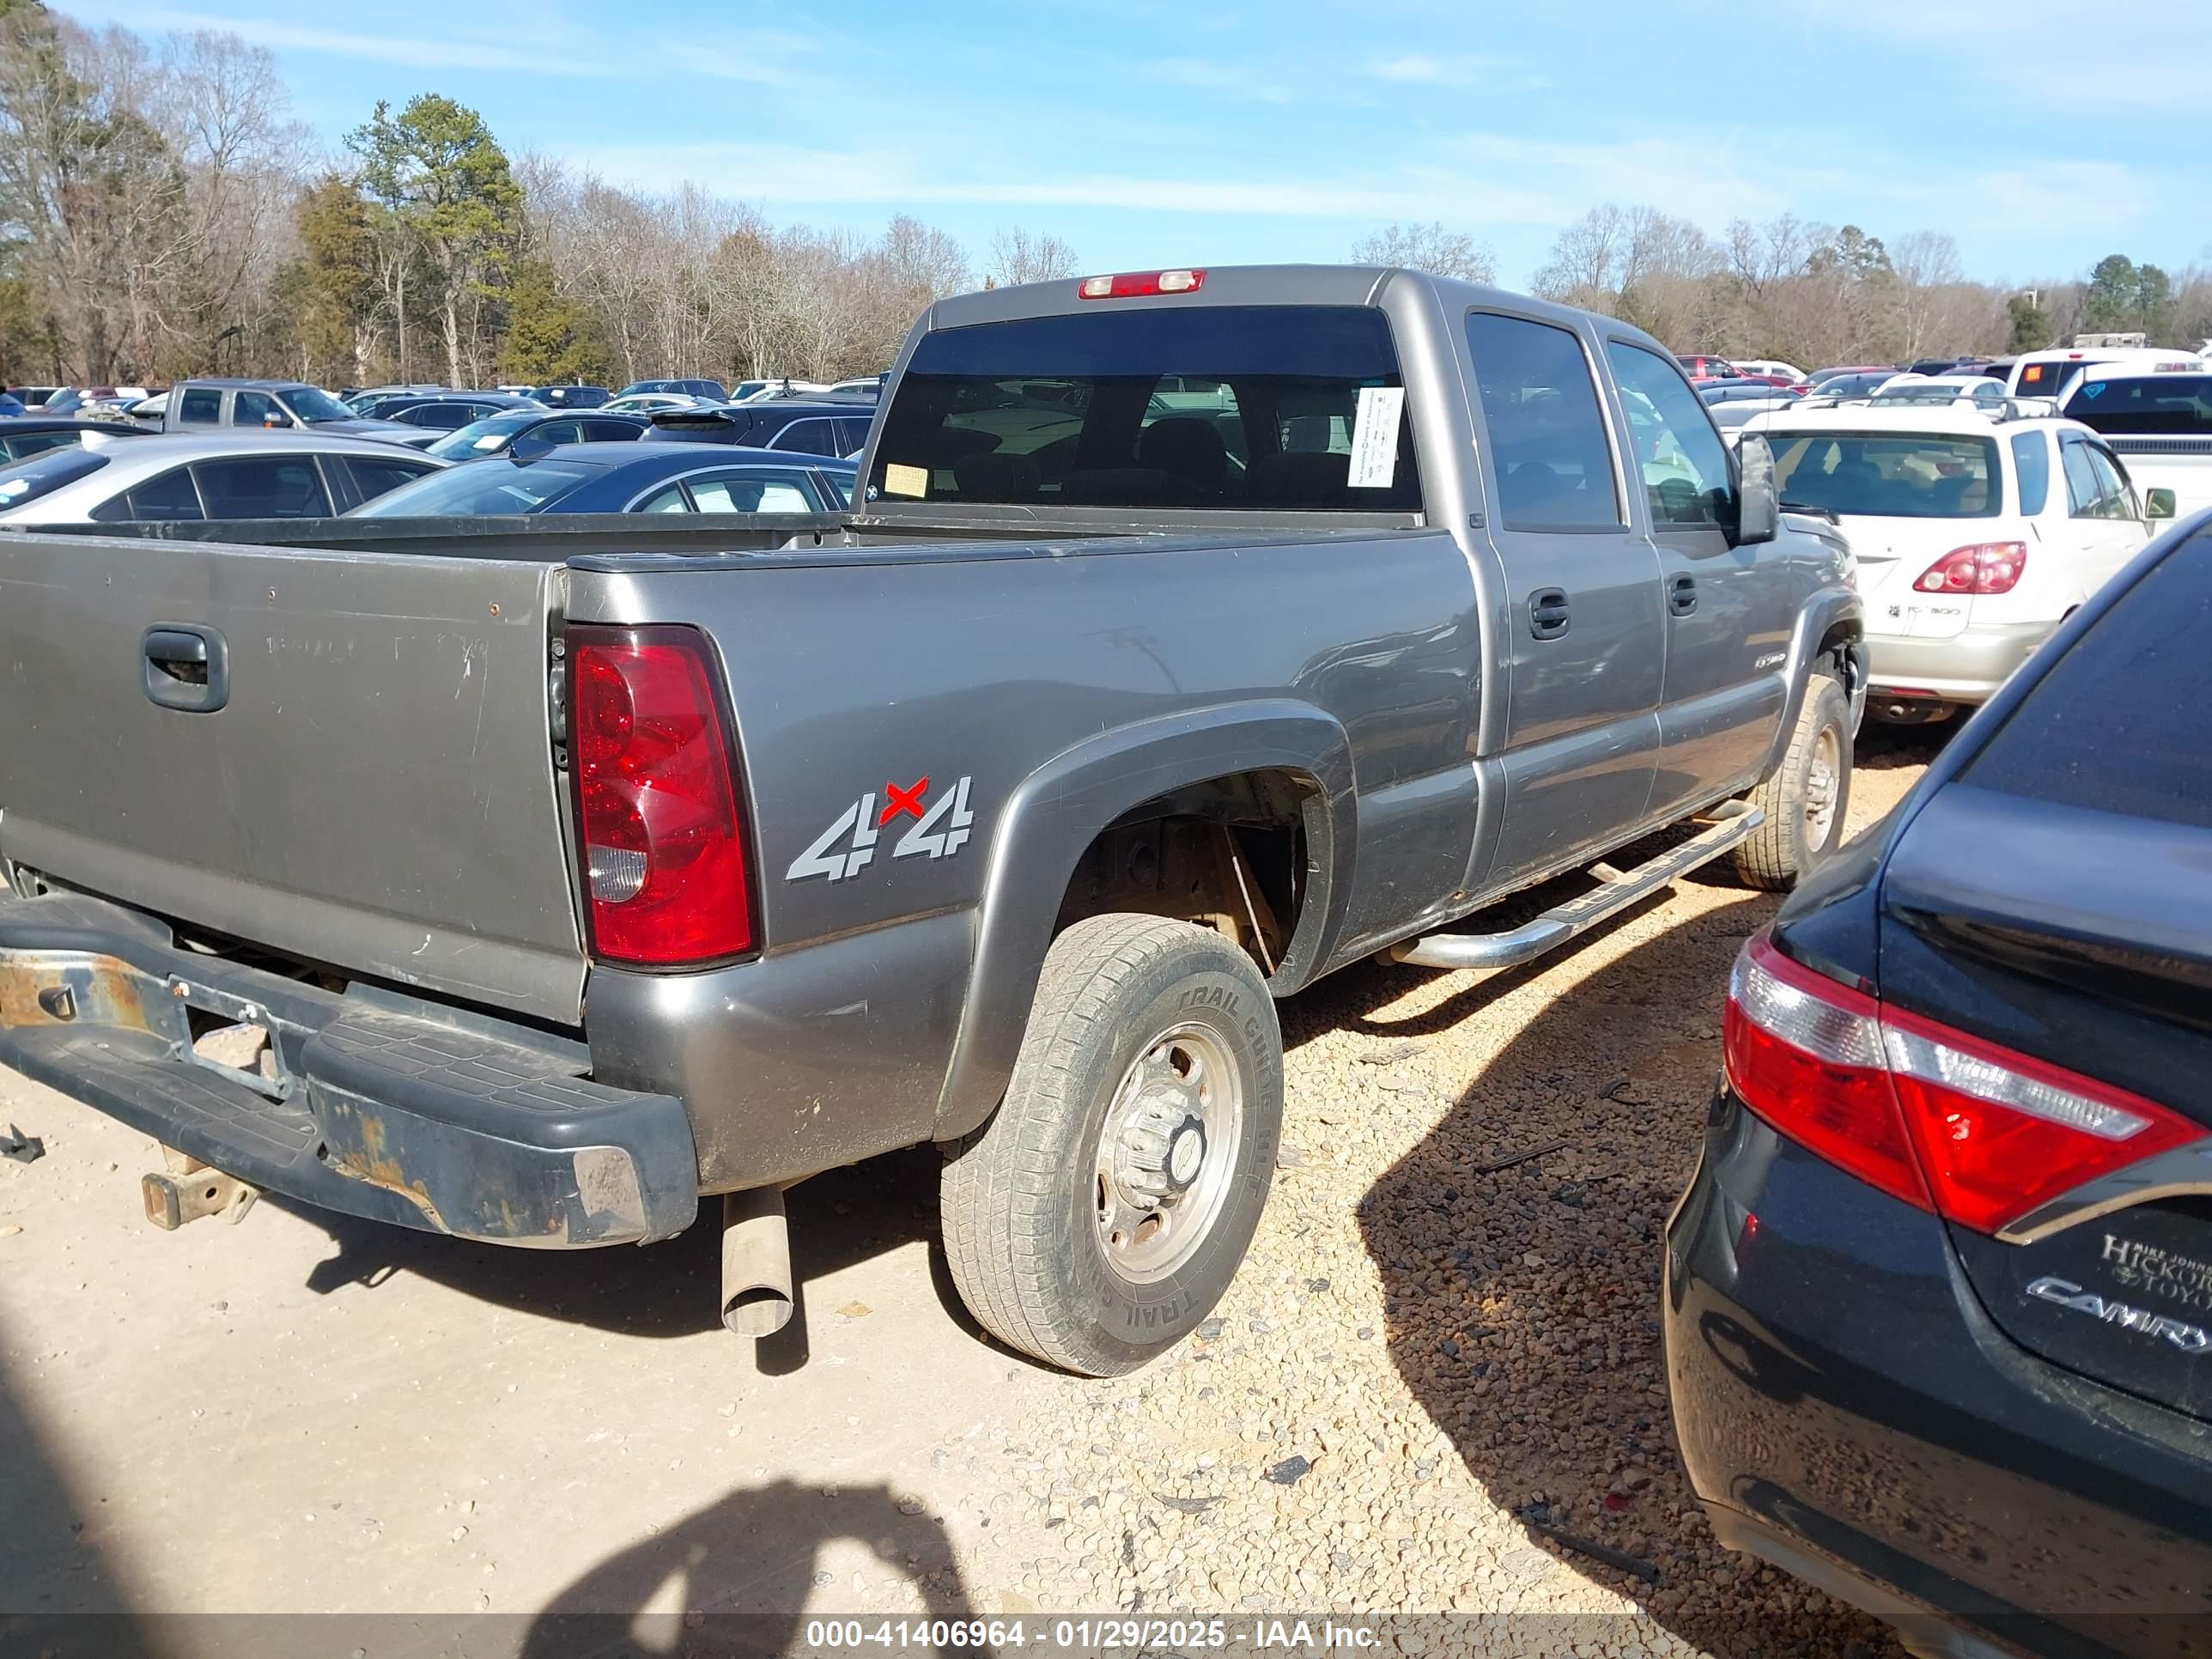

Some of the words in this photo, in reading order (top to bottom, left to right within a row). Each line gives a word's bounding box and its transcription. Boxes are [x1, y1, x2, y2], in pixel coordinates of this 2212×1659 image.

[1178, 986, 1239, 1018] TRAIL
[1244, 1016, 1273, 1114] GUIDE
[2133, 1243, 2166, 1260] MIKE
[1123, 1289, 1200, 1329] TRAIL
